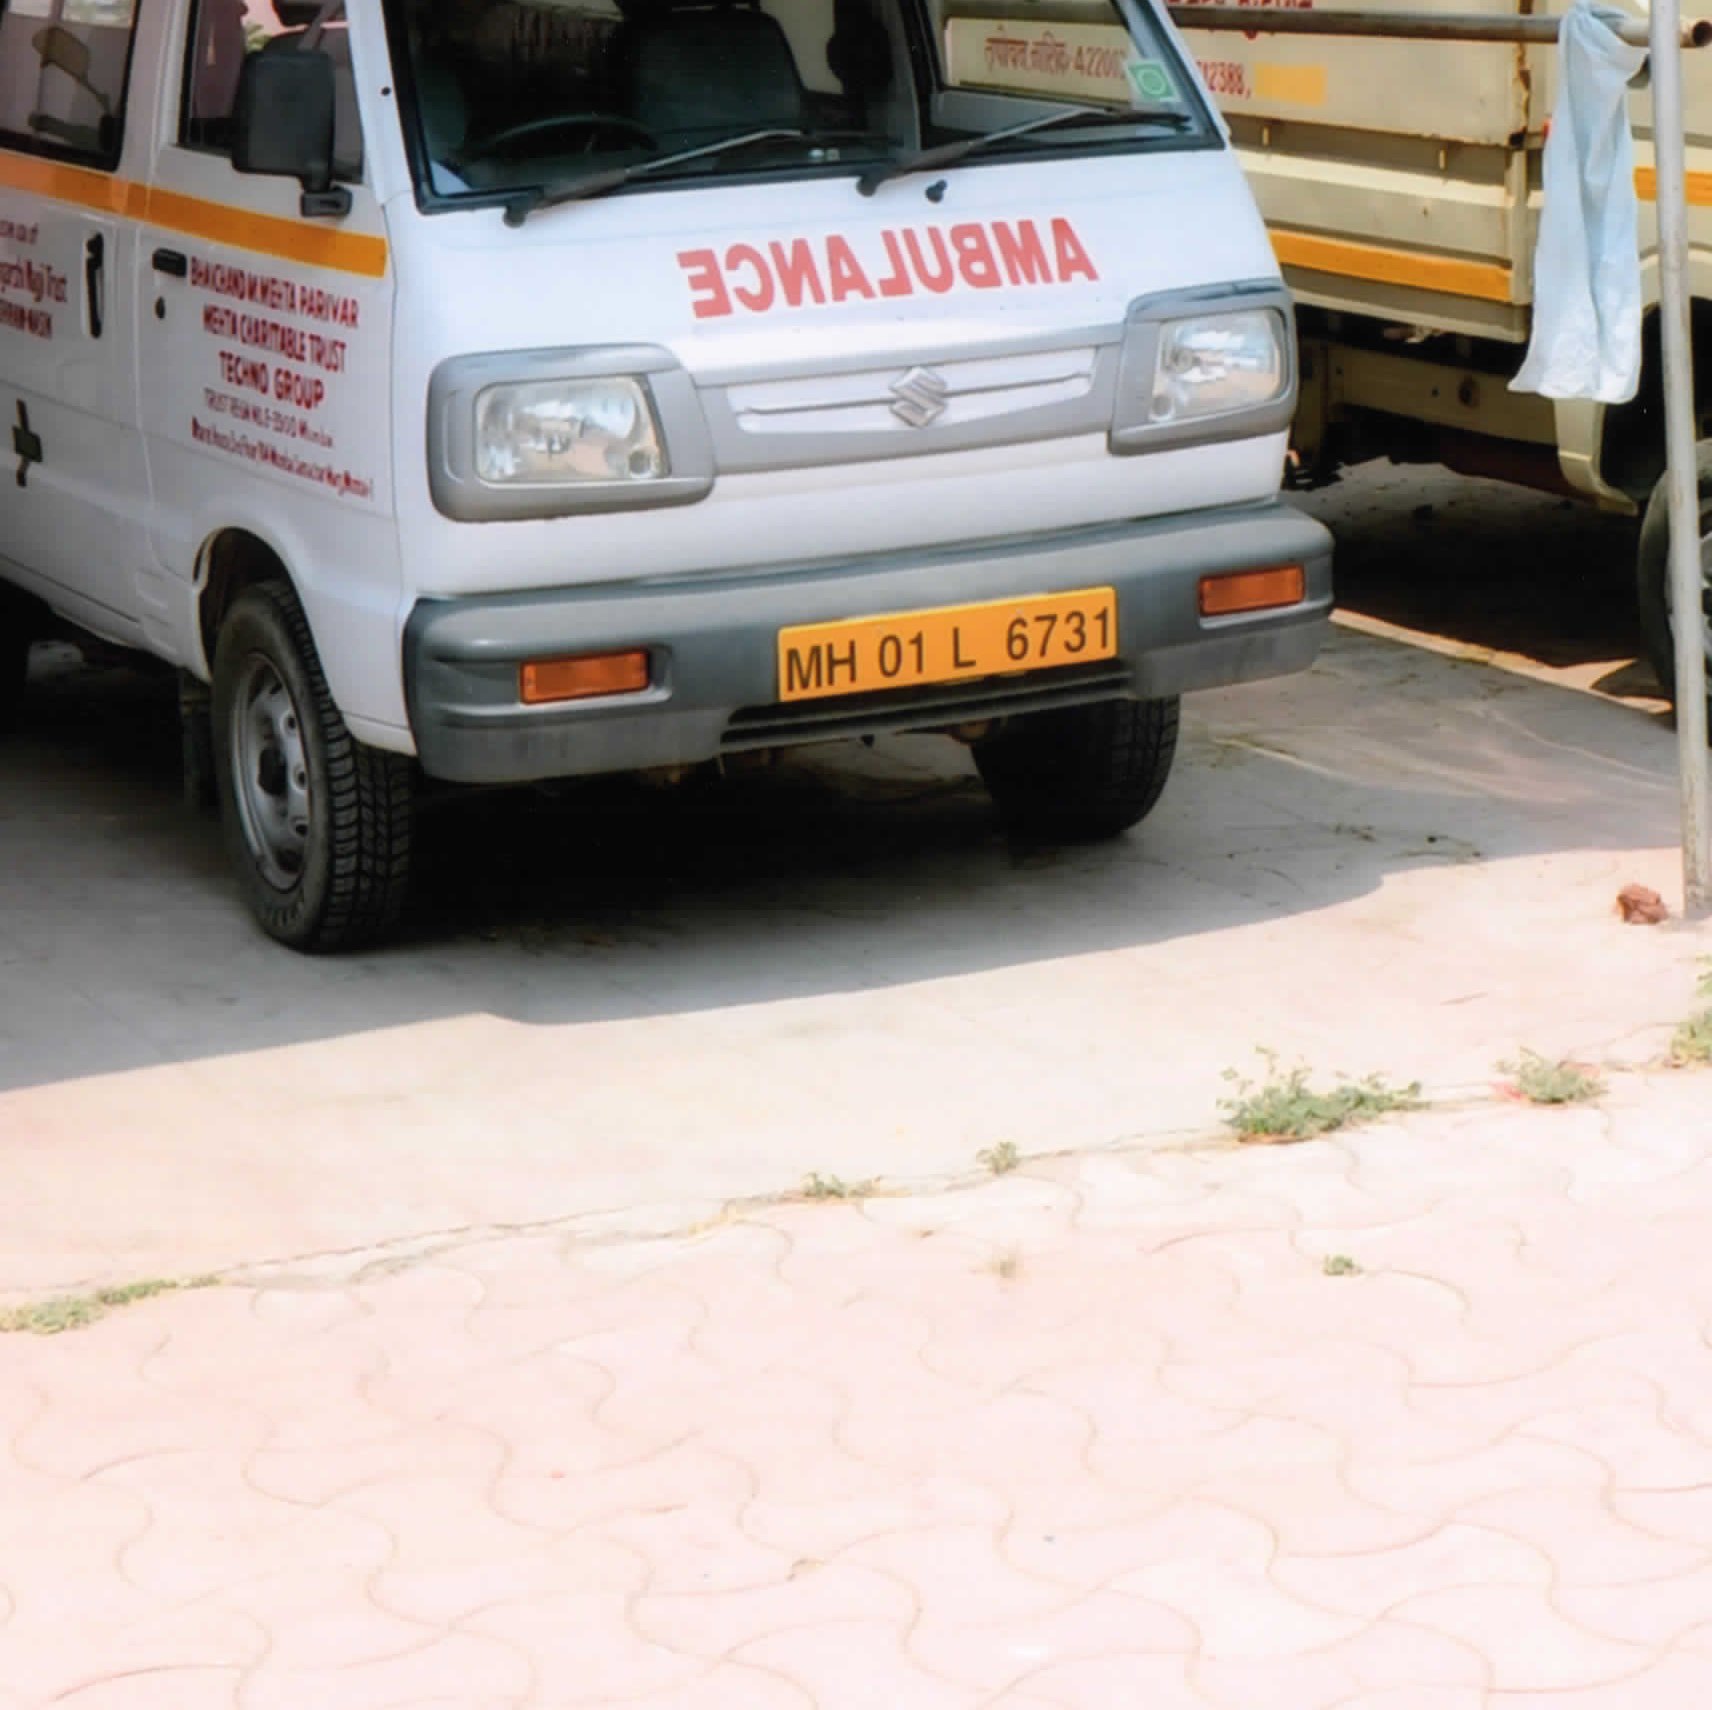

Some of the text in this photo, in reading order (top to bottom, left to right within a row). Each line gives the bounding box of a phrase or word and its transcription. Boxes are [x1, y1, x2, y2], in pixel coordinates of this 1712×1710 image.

[218, 350, 325, 410] TECHNO GROUP
[785, 607, 1109, 694] MH 01 L 6731
